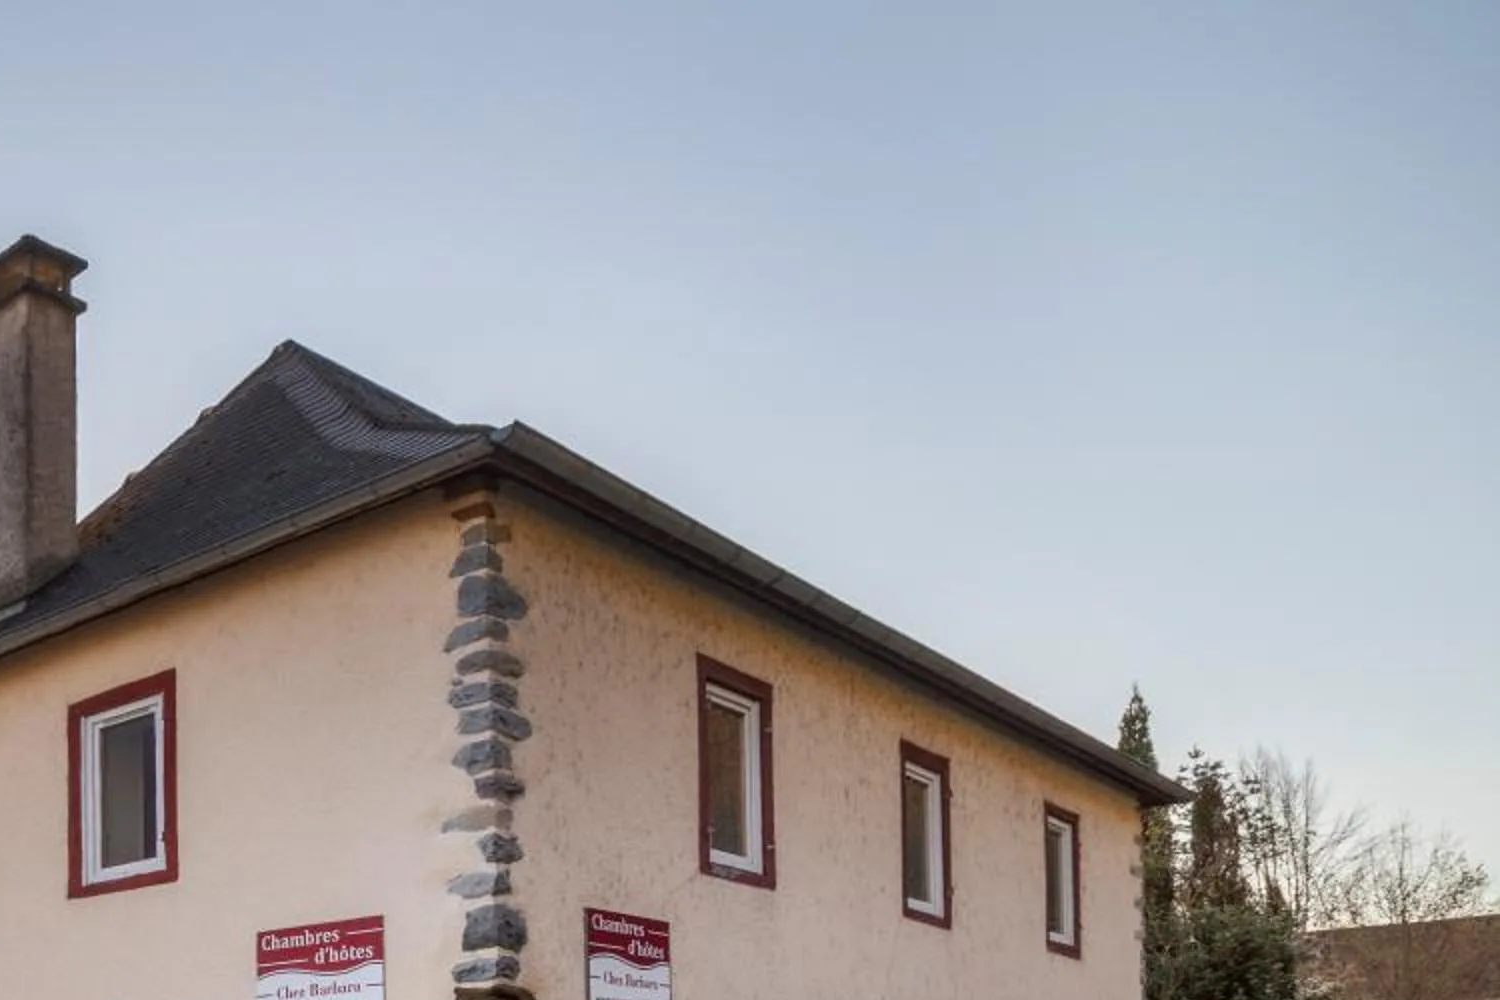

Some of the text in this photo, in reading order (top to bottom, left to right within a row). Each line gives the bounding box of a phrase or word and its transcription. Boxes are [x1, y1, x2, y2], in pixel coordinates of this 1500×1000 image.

[591, 913, 645, 937] Chambres
[261, 929, 341, 951] Chambres
[627, 939, 665, 960] d'hôtes
[315, 945, 374, 964] d'hôtes
[277, 985, 305, 1000] Chez
